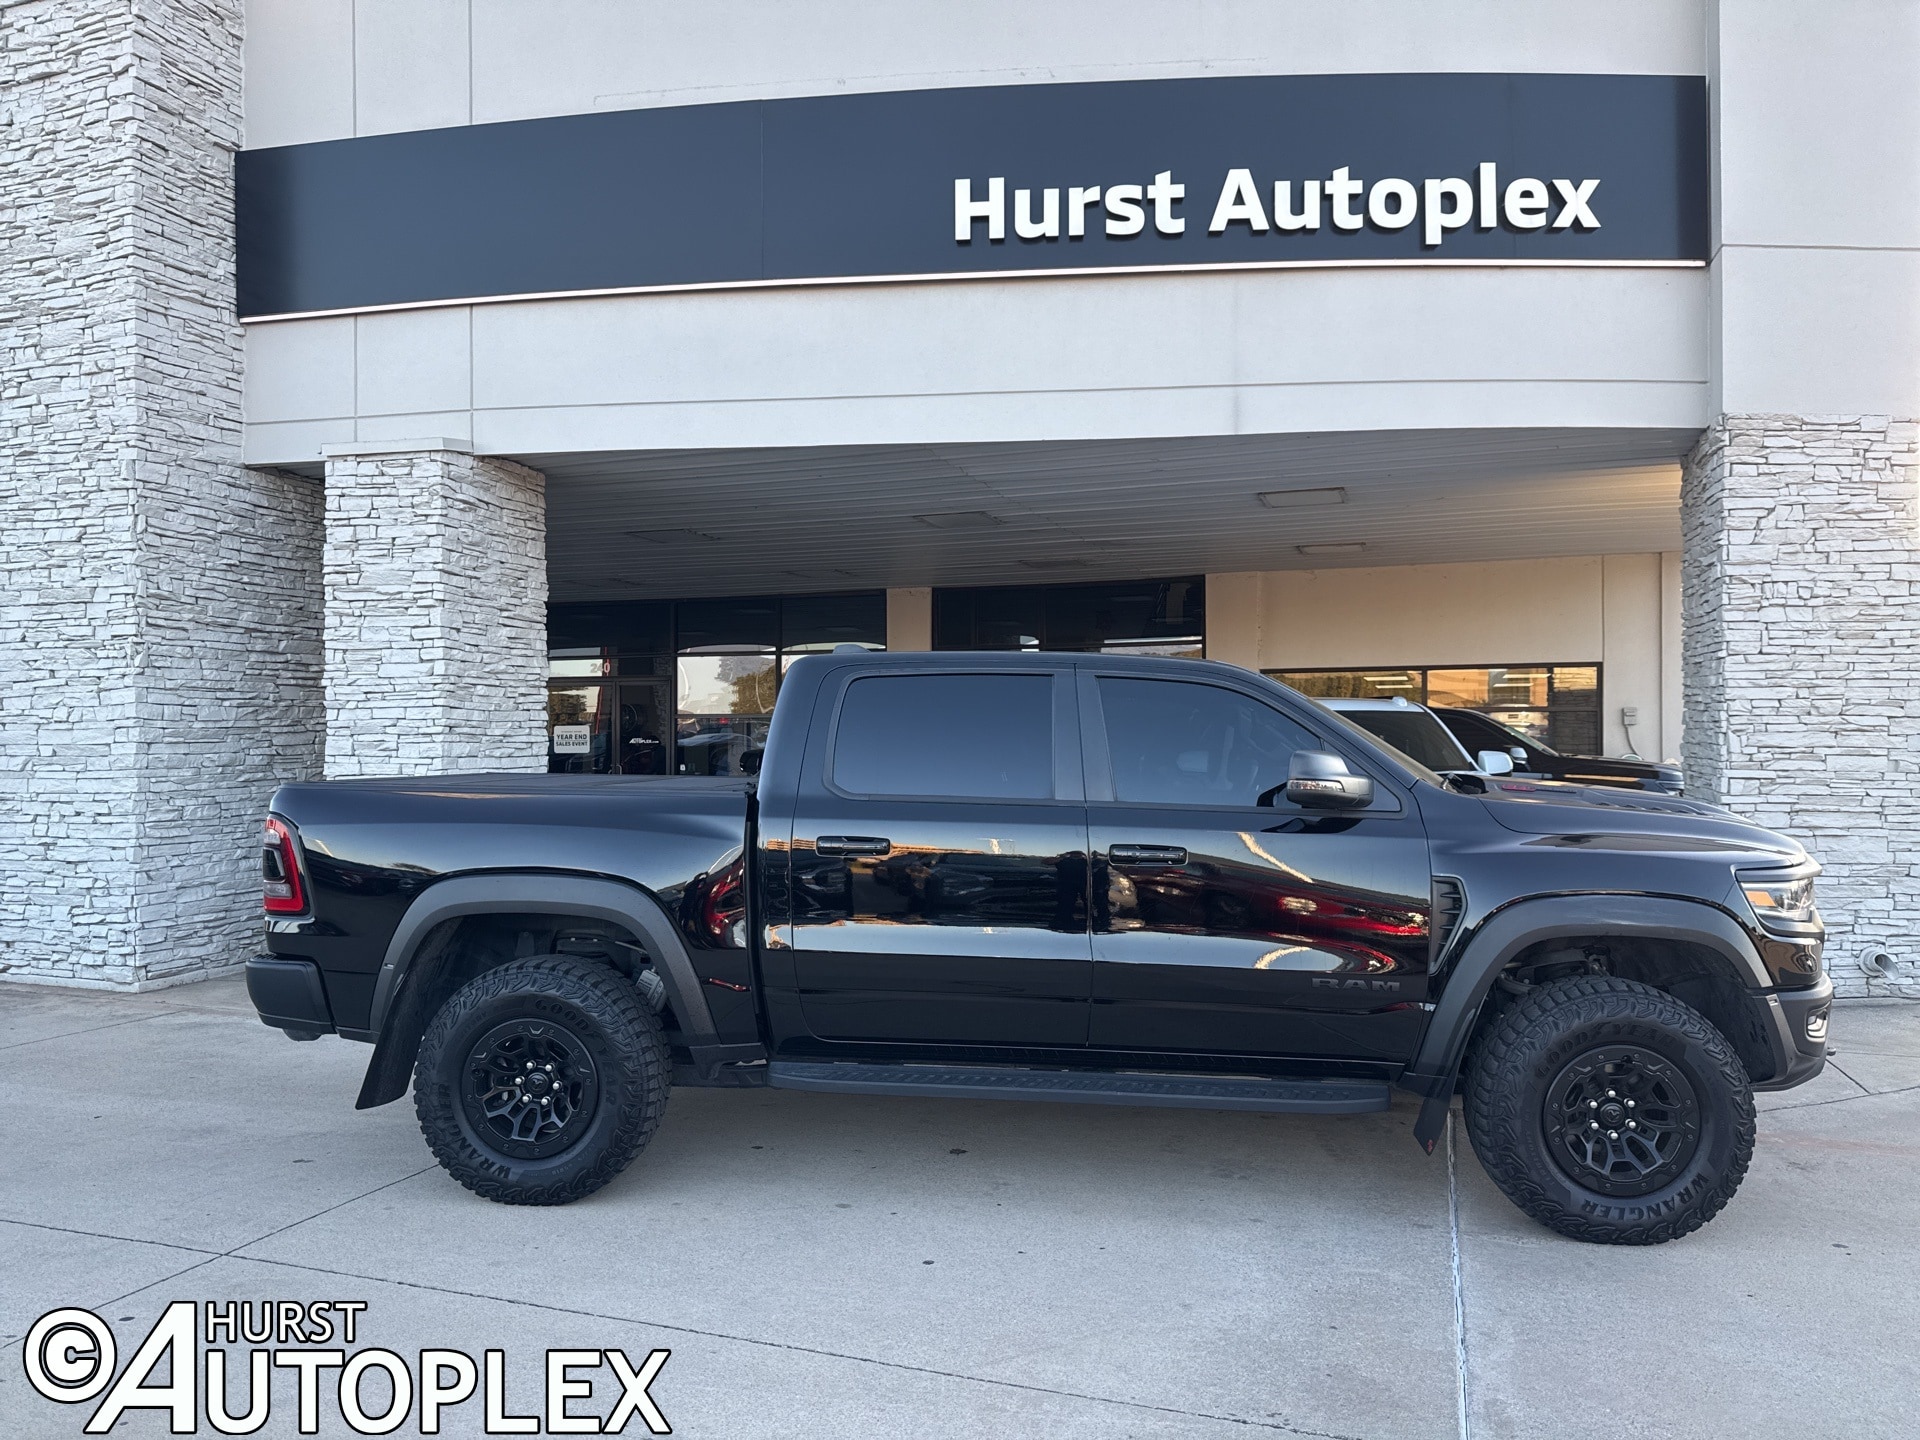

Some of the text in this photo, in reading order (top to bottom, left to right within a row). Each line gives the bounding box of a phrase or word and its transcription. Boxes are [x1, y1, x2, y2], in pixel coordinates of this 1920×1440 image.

[954, 161, 1602, 246] Hurst Autoplex
[590, 662, 611, 673] 240
[1311, 977, 1400, 992] RAM
[1581, 1173, 1711, 1222] WRANGLER
